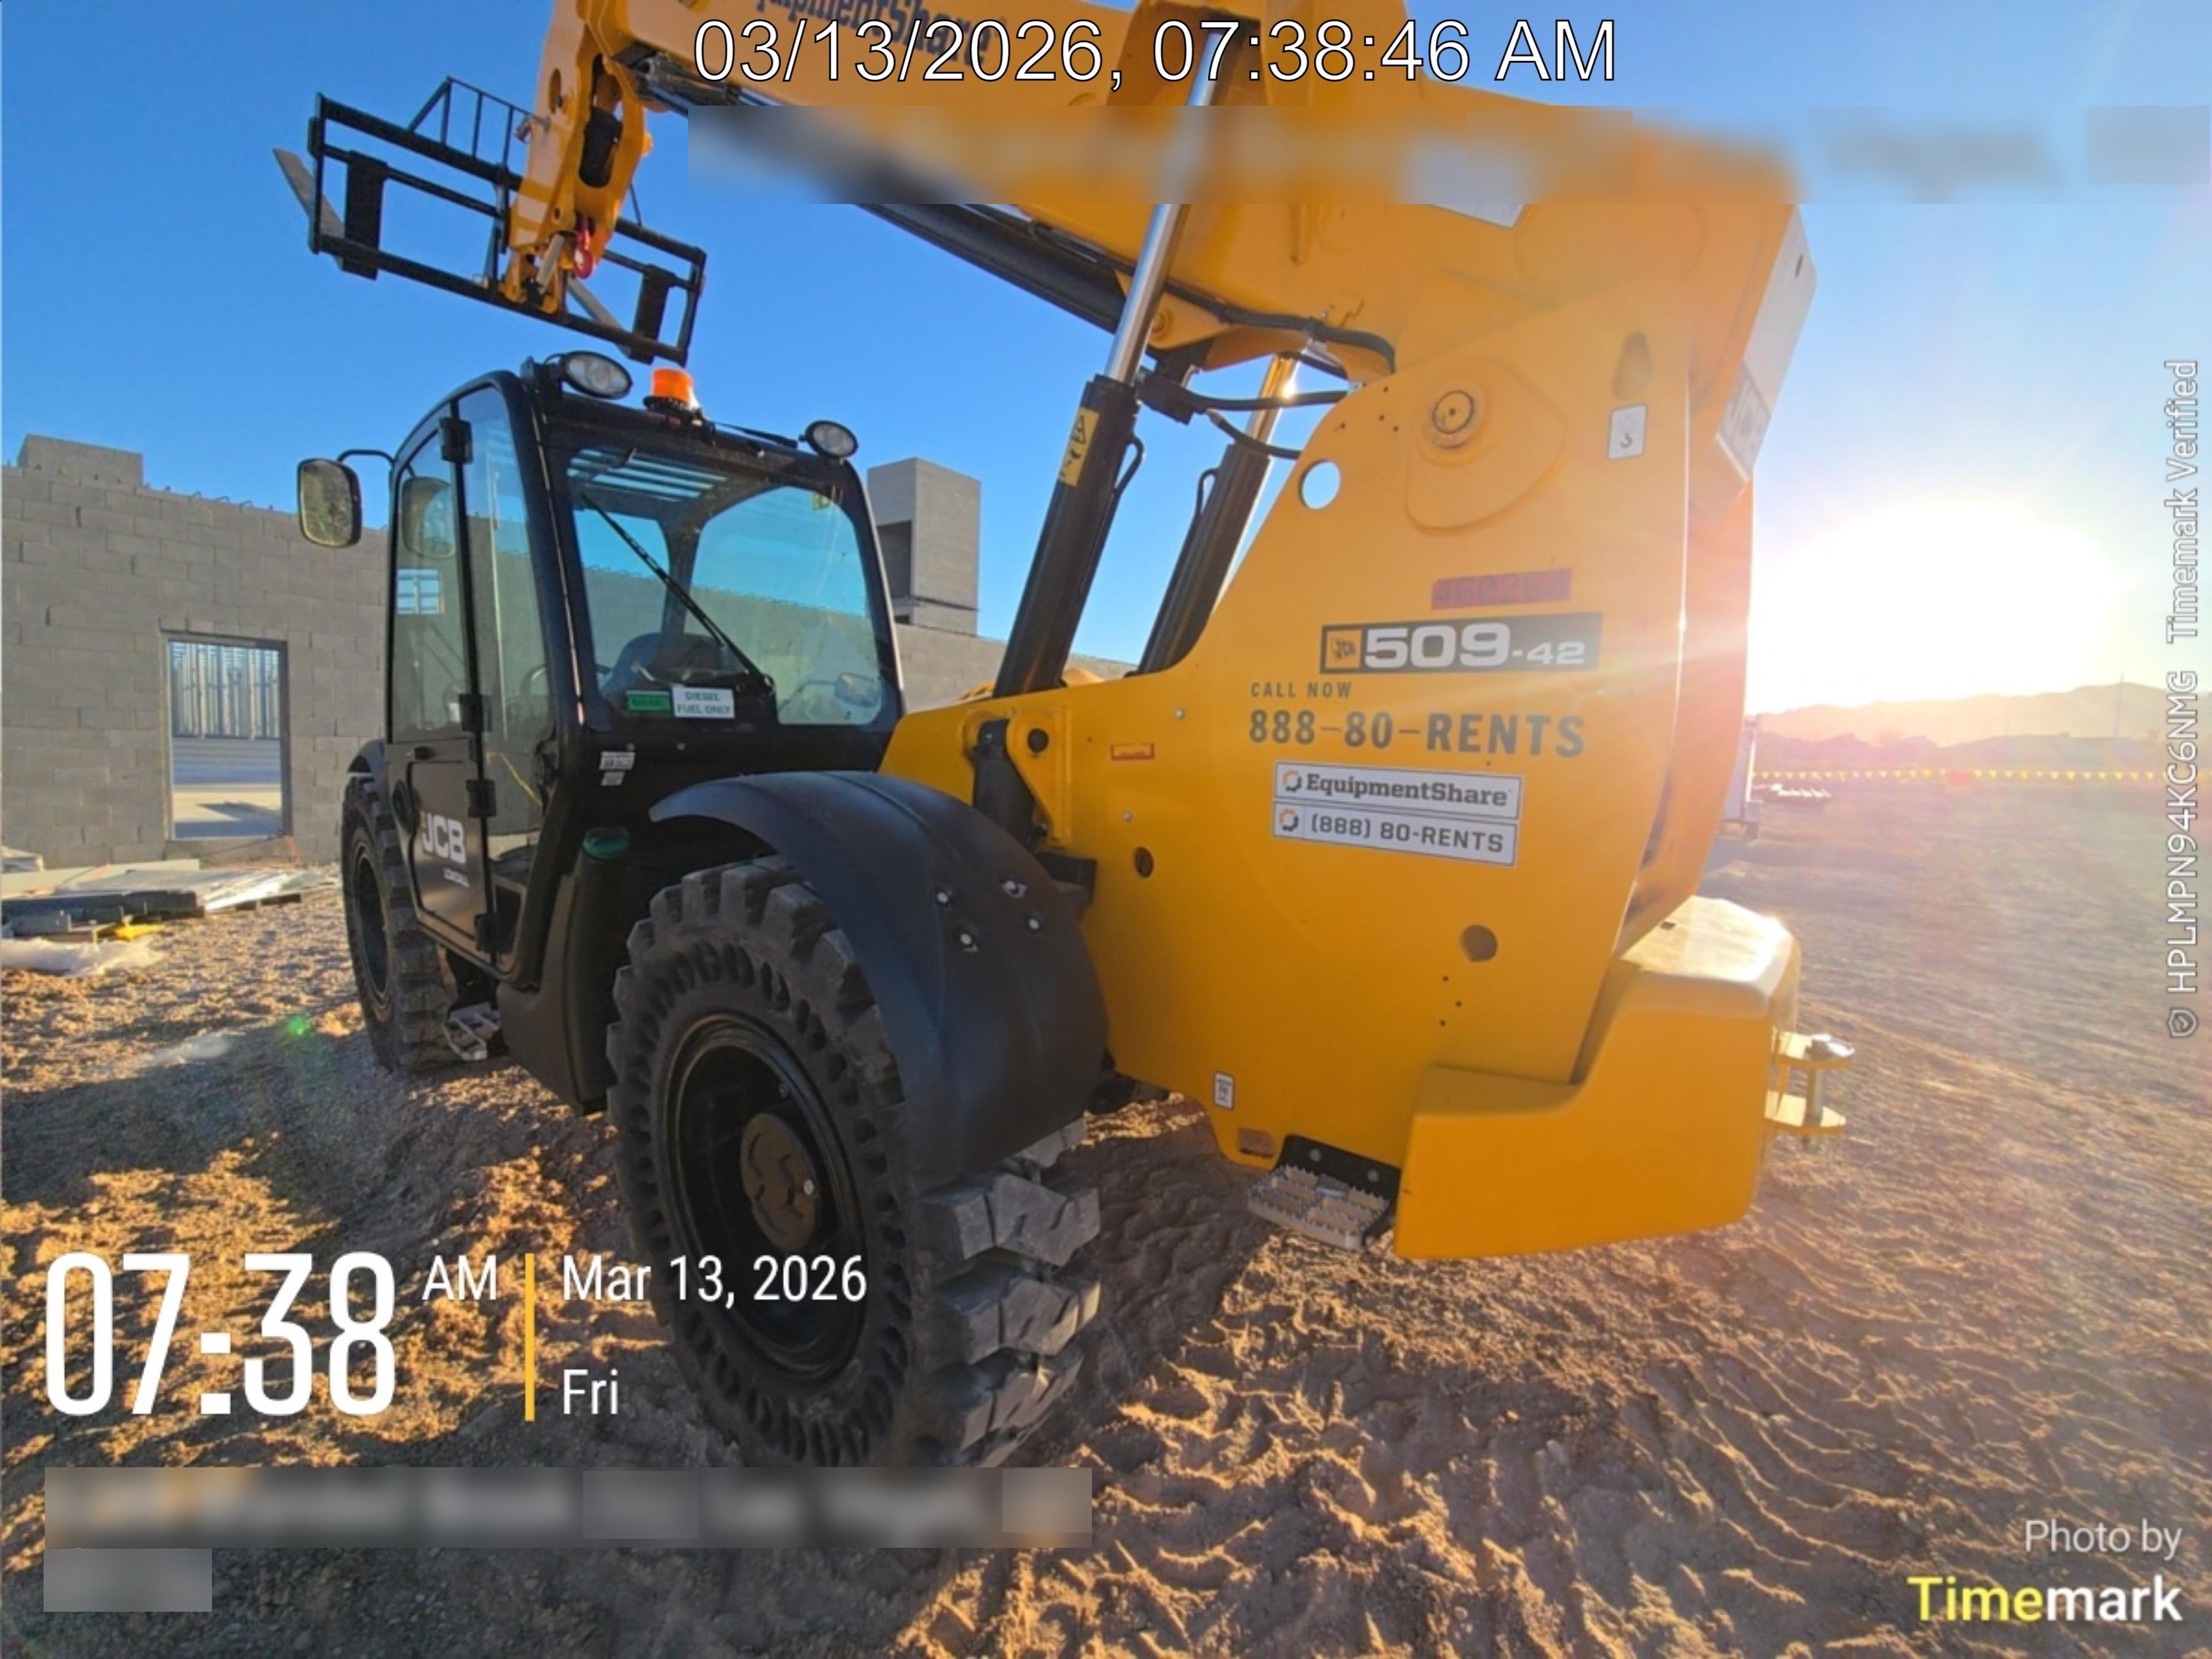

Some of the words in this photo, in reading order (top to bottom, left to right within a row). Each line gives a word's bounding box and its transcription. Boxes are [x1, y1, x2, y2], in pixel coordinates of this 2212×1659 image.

[1365, 622, 1585, 668] 509-42
[685, 691, 720, 701] DIESEL
[1250, 682, 1296, 698] CALL
[1307, 682, 1352, 698] NOW
[677, 704, 701, 714] FUEL
[705, 705, 731, 715] ONLY
[1249, 708, 1586, 758] 888-80-RENTS
[1306, 773, 1507, 806] EquipmentShare
[420, 811, 466, 864] JCB
[1311, 813, 1371, 838] (888)
[1380, 822, 1504, 853] 80-RENTS
